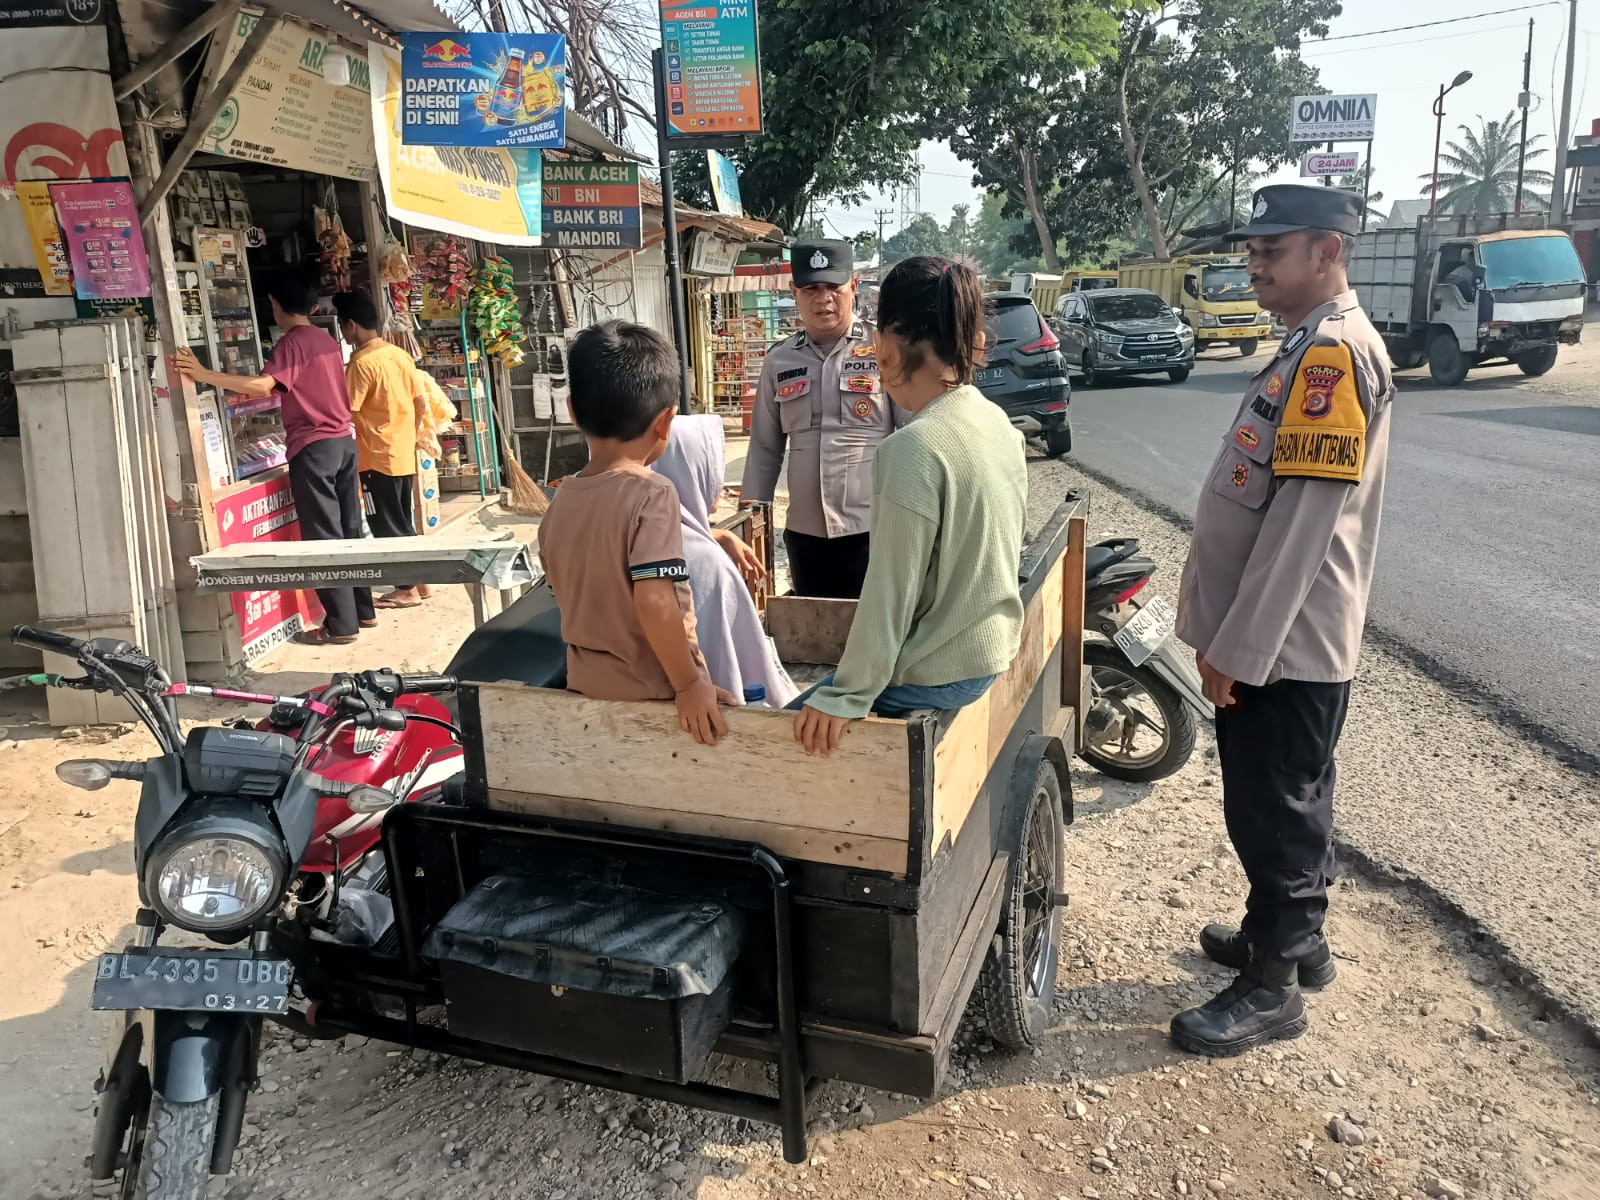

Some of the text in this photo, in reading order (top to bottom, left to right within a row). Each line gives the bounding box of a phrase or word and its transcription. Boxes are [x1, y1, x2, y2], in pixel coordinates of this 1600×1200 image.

[675, 11, 694, 19] AGEN
[721, 7, 748, 19] ATM
[405, 78, 490, 93] DAPATKAN
[405, 95, 460, 109] ENERGI
[405, 111, 459, 125] DI SINI!
[507, 120, 556, 138] SATU ENERGI
[495, 129, 559, 146] SATU SEMANGAT
[1318, 158, 1355, 168] 24 JAM
[543, 166, 629, 181] BANK ACEH
[575, 188, 600, 203] BNI
[553, 209, 624, 225] BANK BRI
[558, 231, 620, 246] MANDIRI
[1306, 366, 1339, 376] POLRES
[1299, 432, 1360, 468] KAMTIBMAS
[257, 572, 305, 584] KARENA
[306, 569, 382, 584] PERINGATAN:
[271, 617, 303, 644] PONSEL
[98, 954, 135, 979] BL
[144, 956, 220, 983] 4335
